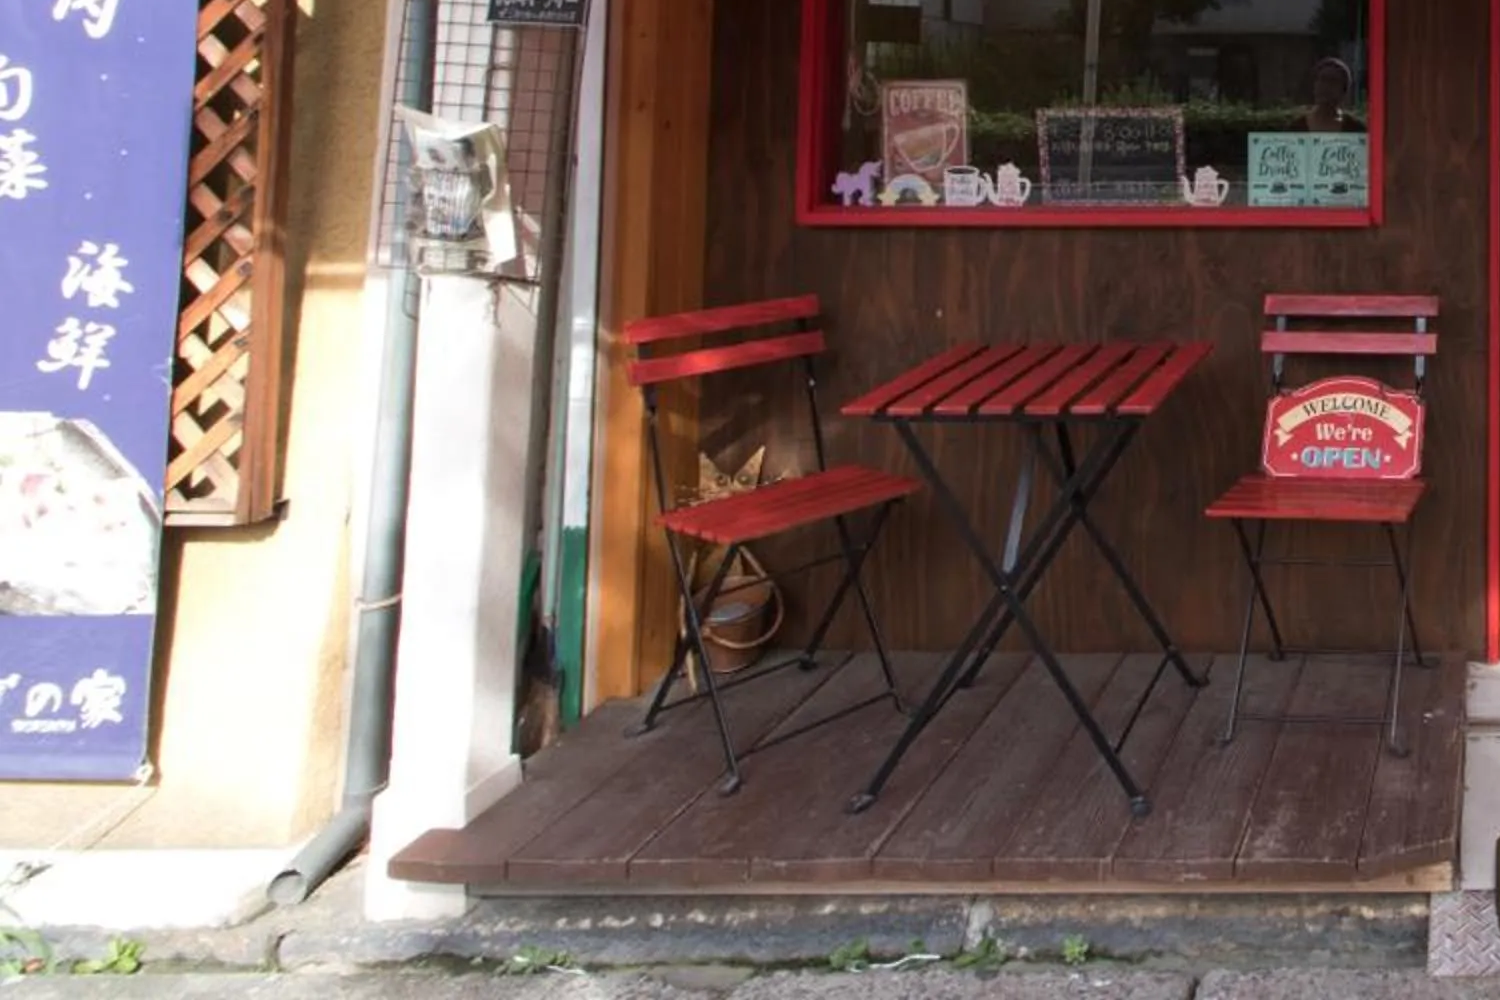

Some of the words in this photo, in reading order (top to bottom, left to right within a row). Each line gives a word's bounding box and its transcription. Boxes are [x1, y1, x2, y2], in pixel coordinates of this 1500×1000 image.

[1302, 397, 1391, 419] WELCOME
[1315, 422, 1373, 442] We're
[1300, 446, 1382, 469] OPEN
